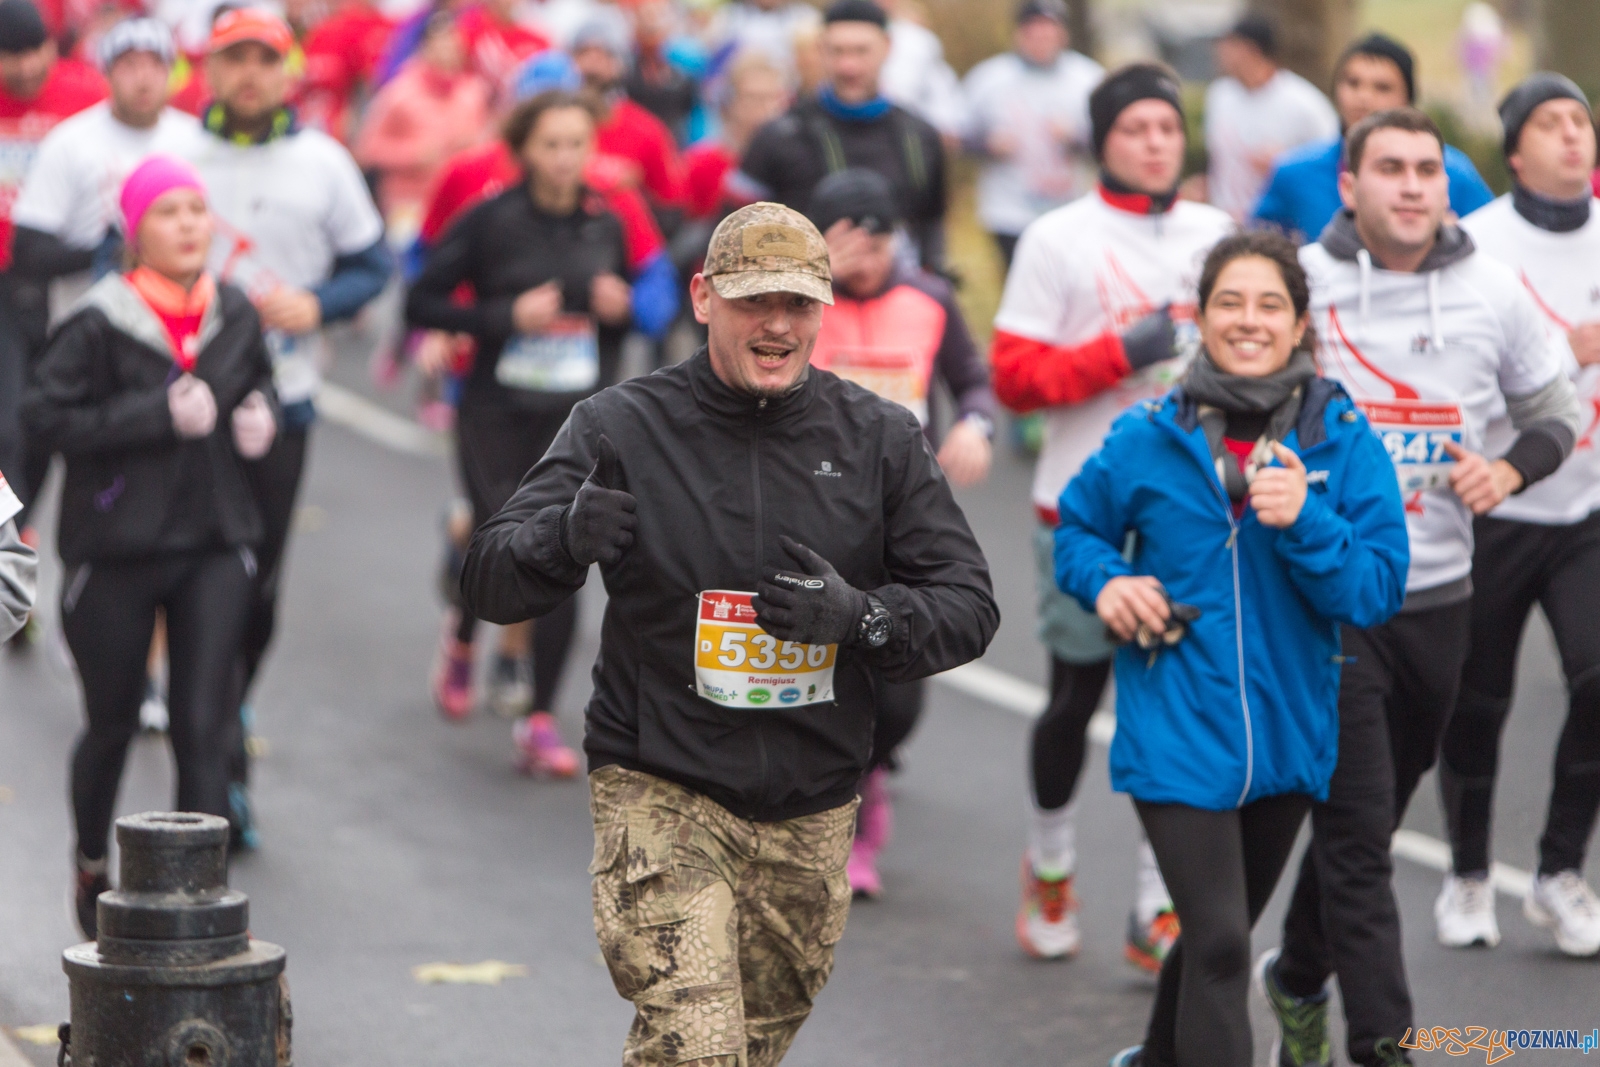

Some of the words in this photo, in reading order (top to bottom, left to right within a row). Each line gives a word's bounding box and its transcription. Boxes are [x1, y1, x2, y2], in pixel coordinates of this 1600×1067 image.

[1376, 431, 1452, 463] 647
[701, 640, 713, 652] D
[717, 631, 828, 670] 5356
[747, 675, 796, 686] Remigiusz
